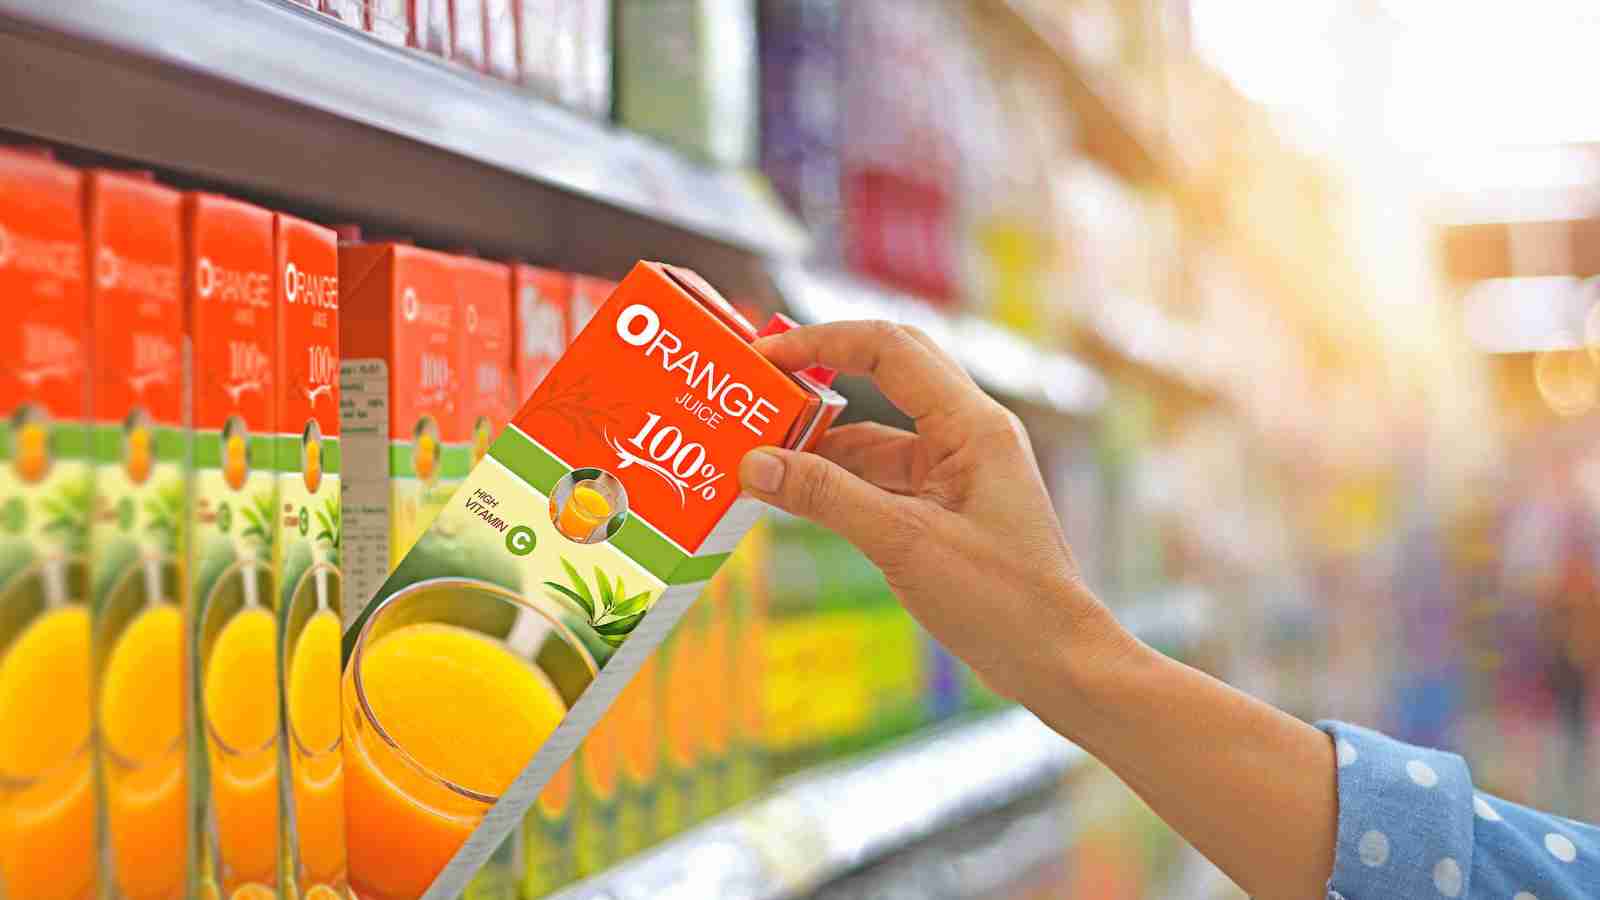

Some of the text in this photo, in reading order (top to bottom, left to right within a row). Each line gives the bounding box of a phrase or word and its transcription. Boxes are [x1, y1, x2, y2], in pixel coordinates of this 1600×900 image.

[285, 262, 338, 309] ORANGE
[616, 303, 780, 436] ORANGE
[674, 392, 724, 430] JUICE
[627, 411, 727, 501] 100%
[465, 497, 509, 533] VITAMIN
[473, 487, 500, 509] HIGH
